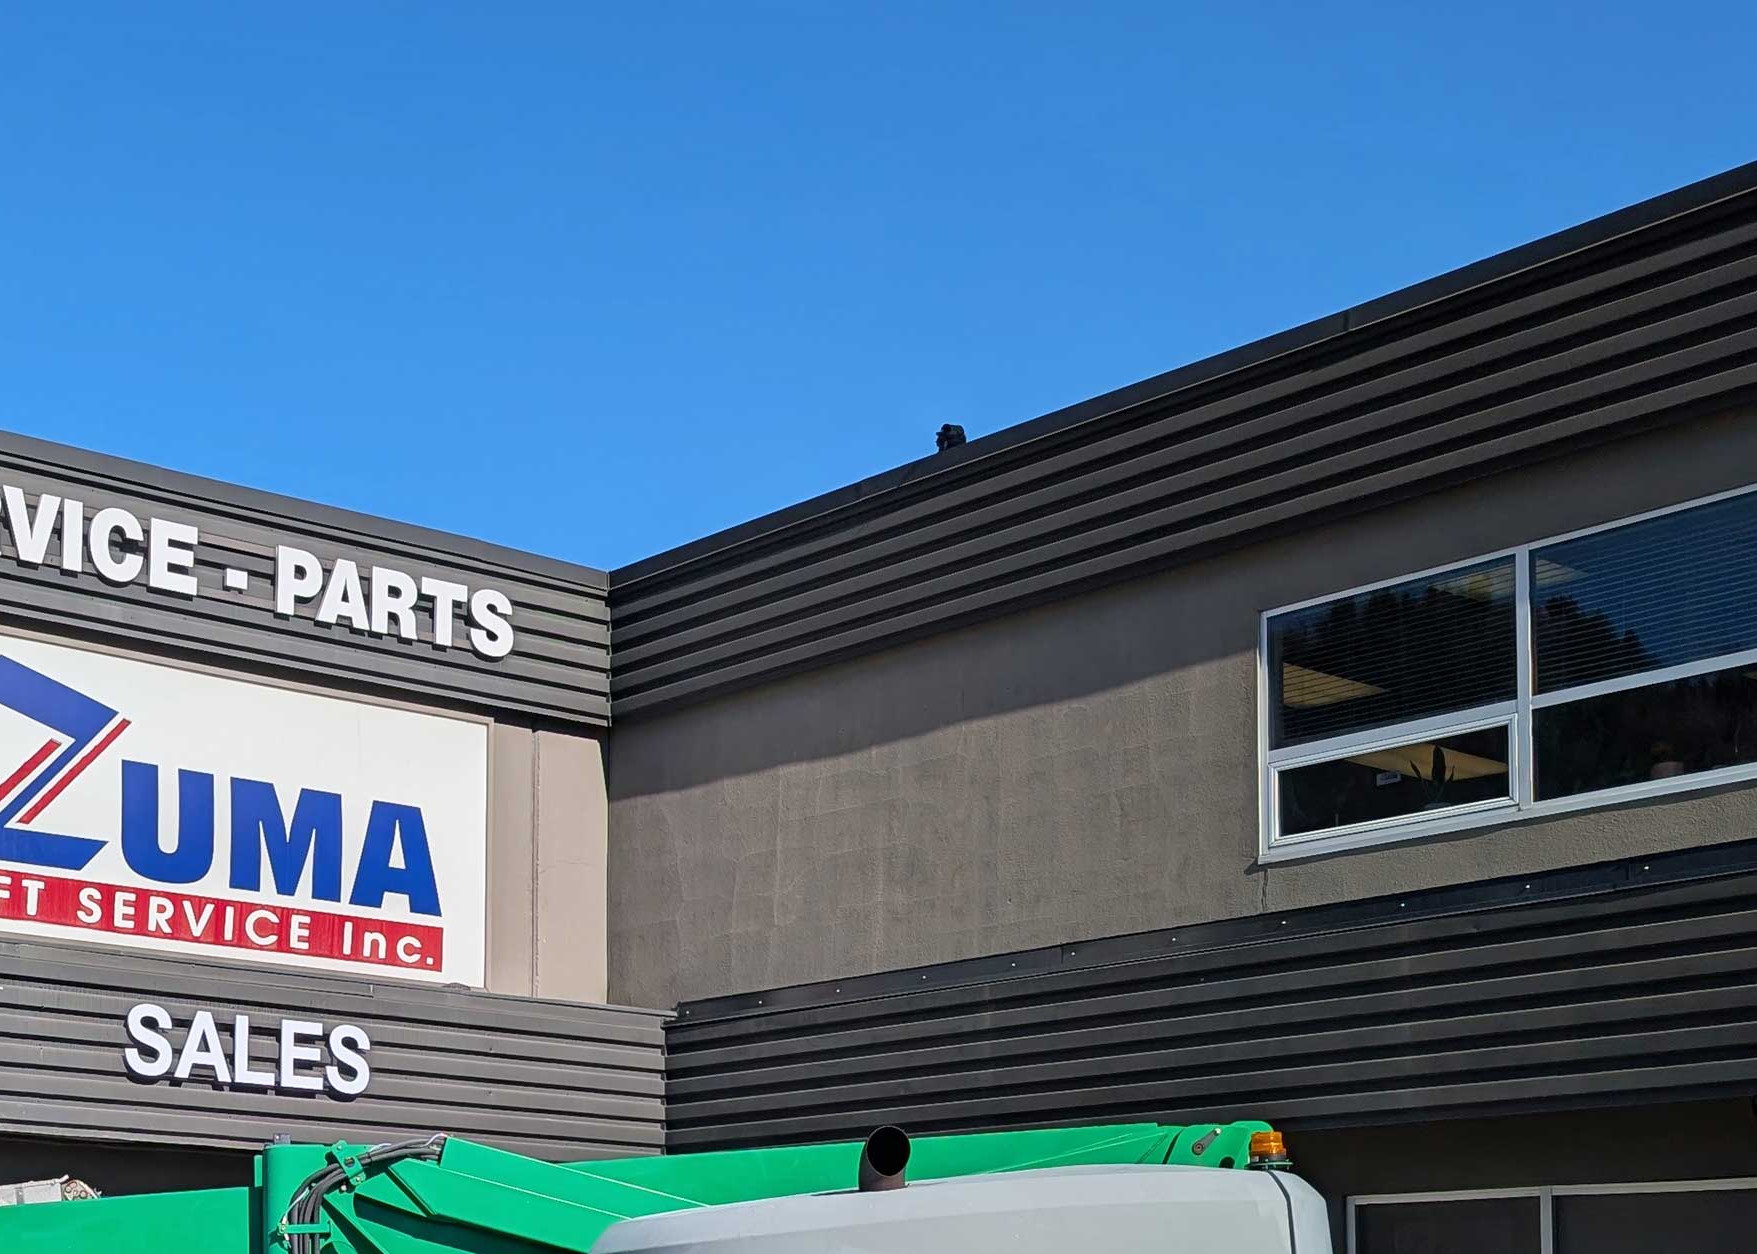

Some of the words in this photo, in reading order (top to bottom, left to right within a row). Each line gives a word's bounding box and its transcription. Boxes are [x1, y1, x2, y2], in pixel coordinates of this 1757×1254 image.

[275, 545, 514, 658] PARTS
[76, 886, 312, 950] SERVICE
[343, 920, 435, 965] Inc.
[125, 1003, 371, 1097] SALES
